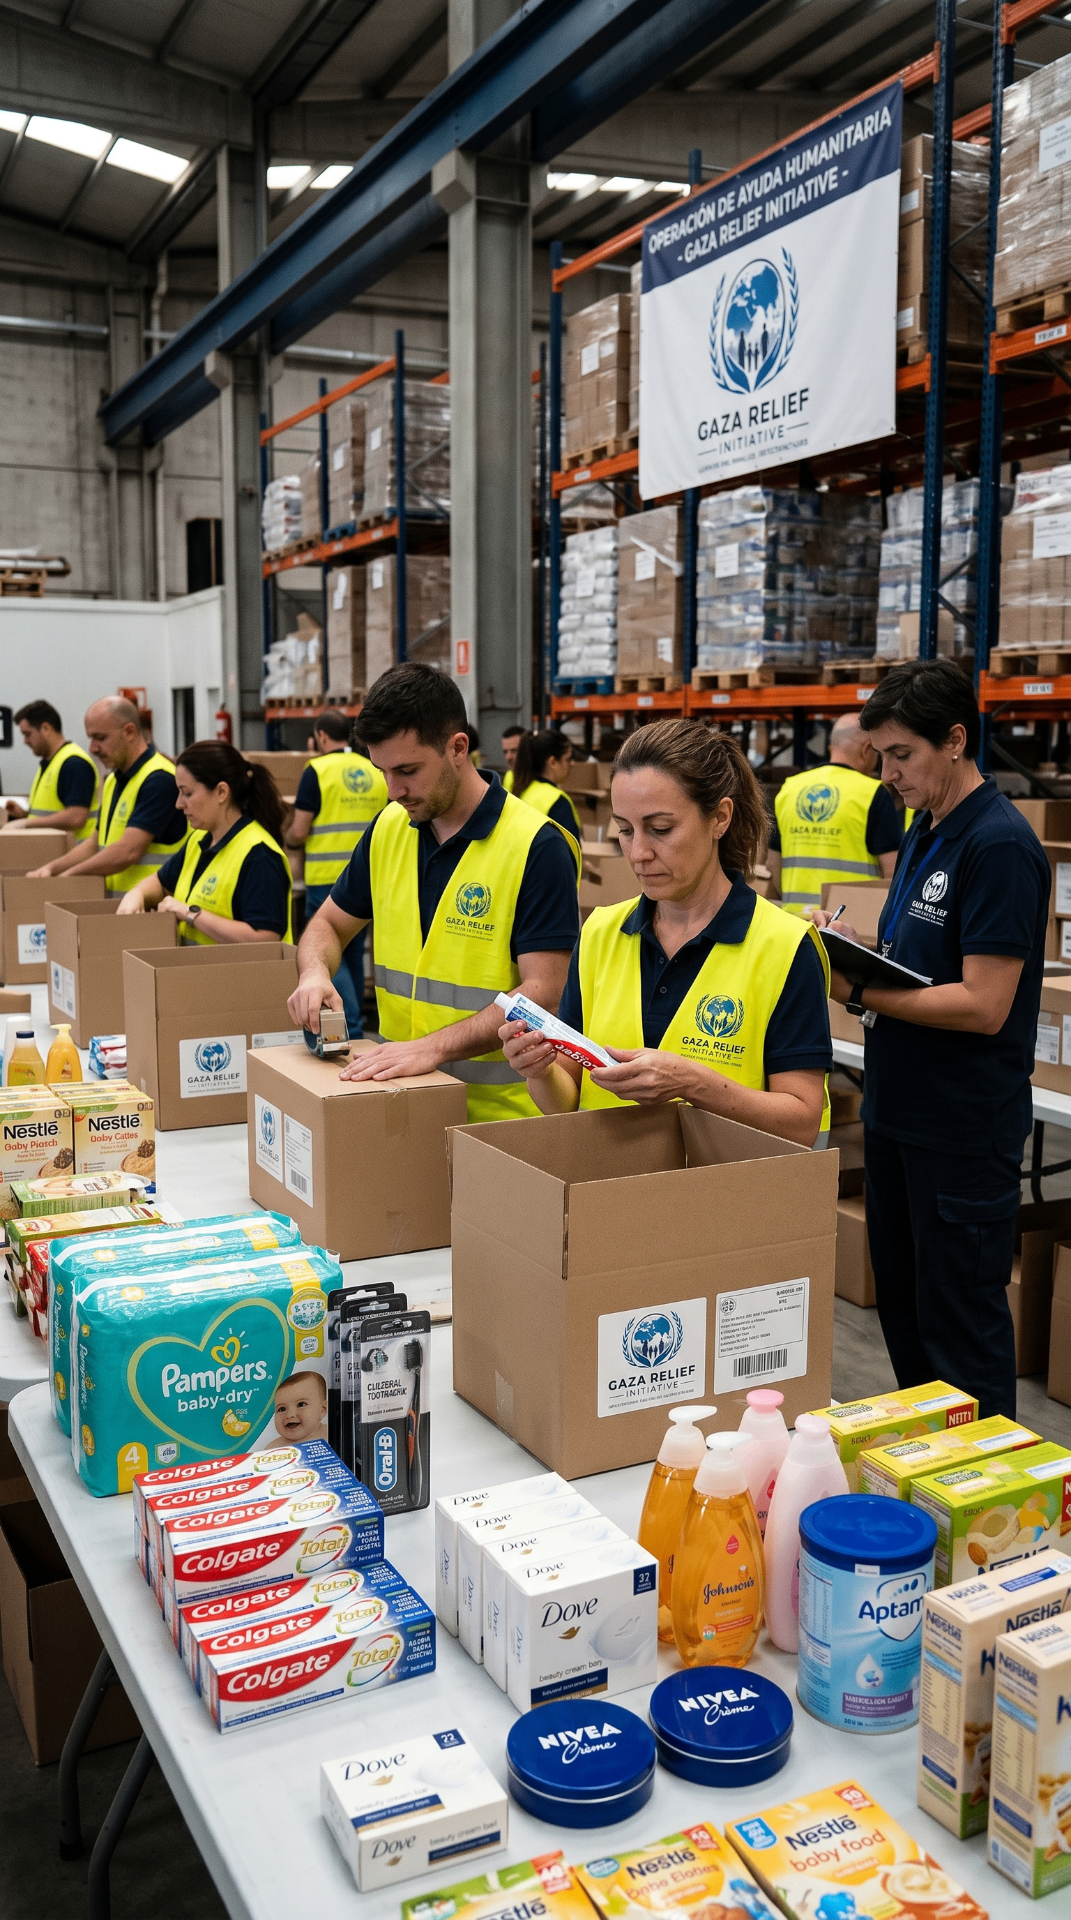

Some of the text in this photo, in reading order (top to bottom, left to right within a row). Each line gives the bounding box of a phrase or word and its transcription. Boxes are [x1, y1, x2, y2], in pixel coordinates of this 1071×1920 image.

[648, 106, 892, 254] OPERACIÓN DE AYUDA HUMANITARIA
[684, 231, 718, 264] GAZA
[720, 209, 763, 247] RELIEF
[765, 165, 840, 224] INITIATIVE
[698, 387, 810, 442] GAZA RELIEF
[719, 424, 785, 455] INITIATIVE
[446, 916, 496, 931] GAZA RELIEF
[682, 1036, 746, 1054] GAZA RELIEF
[690, 1047, 732, 1060] INITIATIVE
[187, 1072, 241, 1084] GAZA RELIEF
[4, 1120, 59, 1140] Nestlé
[88, 1113, 140, 1132] Nestlé
[161, 1360, 268, 1398] Pampers
[608, 1364, 696, 1391] GAZA RELIEF
[626, 1380, 679, 1397] INITIATIVE
[177, 1389, 253, 1413] baby-dry
[125, 1445, 140, 1464] 4
[378, 1433, 393, 1486] Oral-B
[143, 1458, 234, 1482] Colgate
[156, 1482, 250, 1507] Colgate
[450, 1491, 490, 1506] Dove
[173, 1504, 269, 1529] Colgate
[472, 1512, 513, 1529] Dove
[498, 1537, 539, 1553] Dove
[181, 1541, 281, 1575] Colgate
[523, 1561, 566, 1579] Dove
[191, 1586, 291, 1619] Colgate
[541, 1597, 599, 1629] Dove
[858, 1586, 932, 1625] Aptam
[210, 1615, 313, 1651] Colgate
[227, 1653, 331, 1695] Colgate
[678, 1686, 760, 1712] NIVEA
[704, 1704, 755, 1726] Crème
[537, 1722, 622, 1750] NIVEA
[561, 1740, 617, 1764] Crème
[340, 1753, 407, 1781] Dove
[784, 1814, 857, 1851] Nestlé
[371, 1835, 417, 1860] Dove
[789, 1829, 886, 1872] baby food
[626, 1847, 696, 1880] Nestlé
